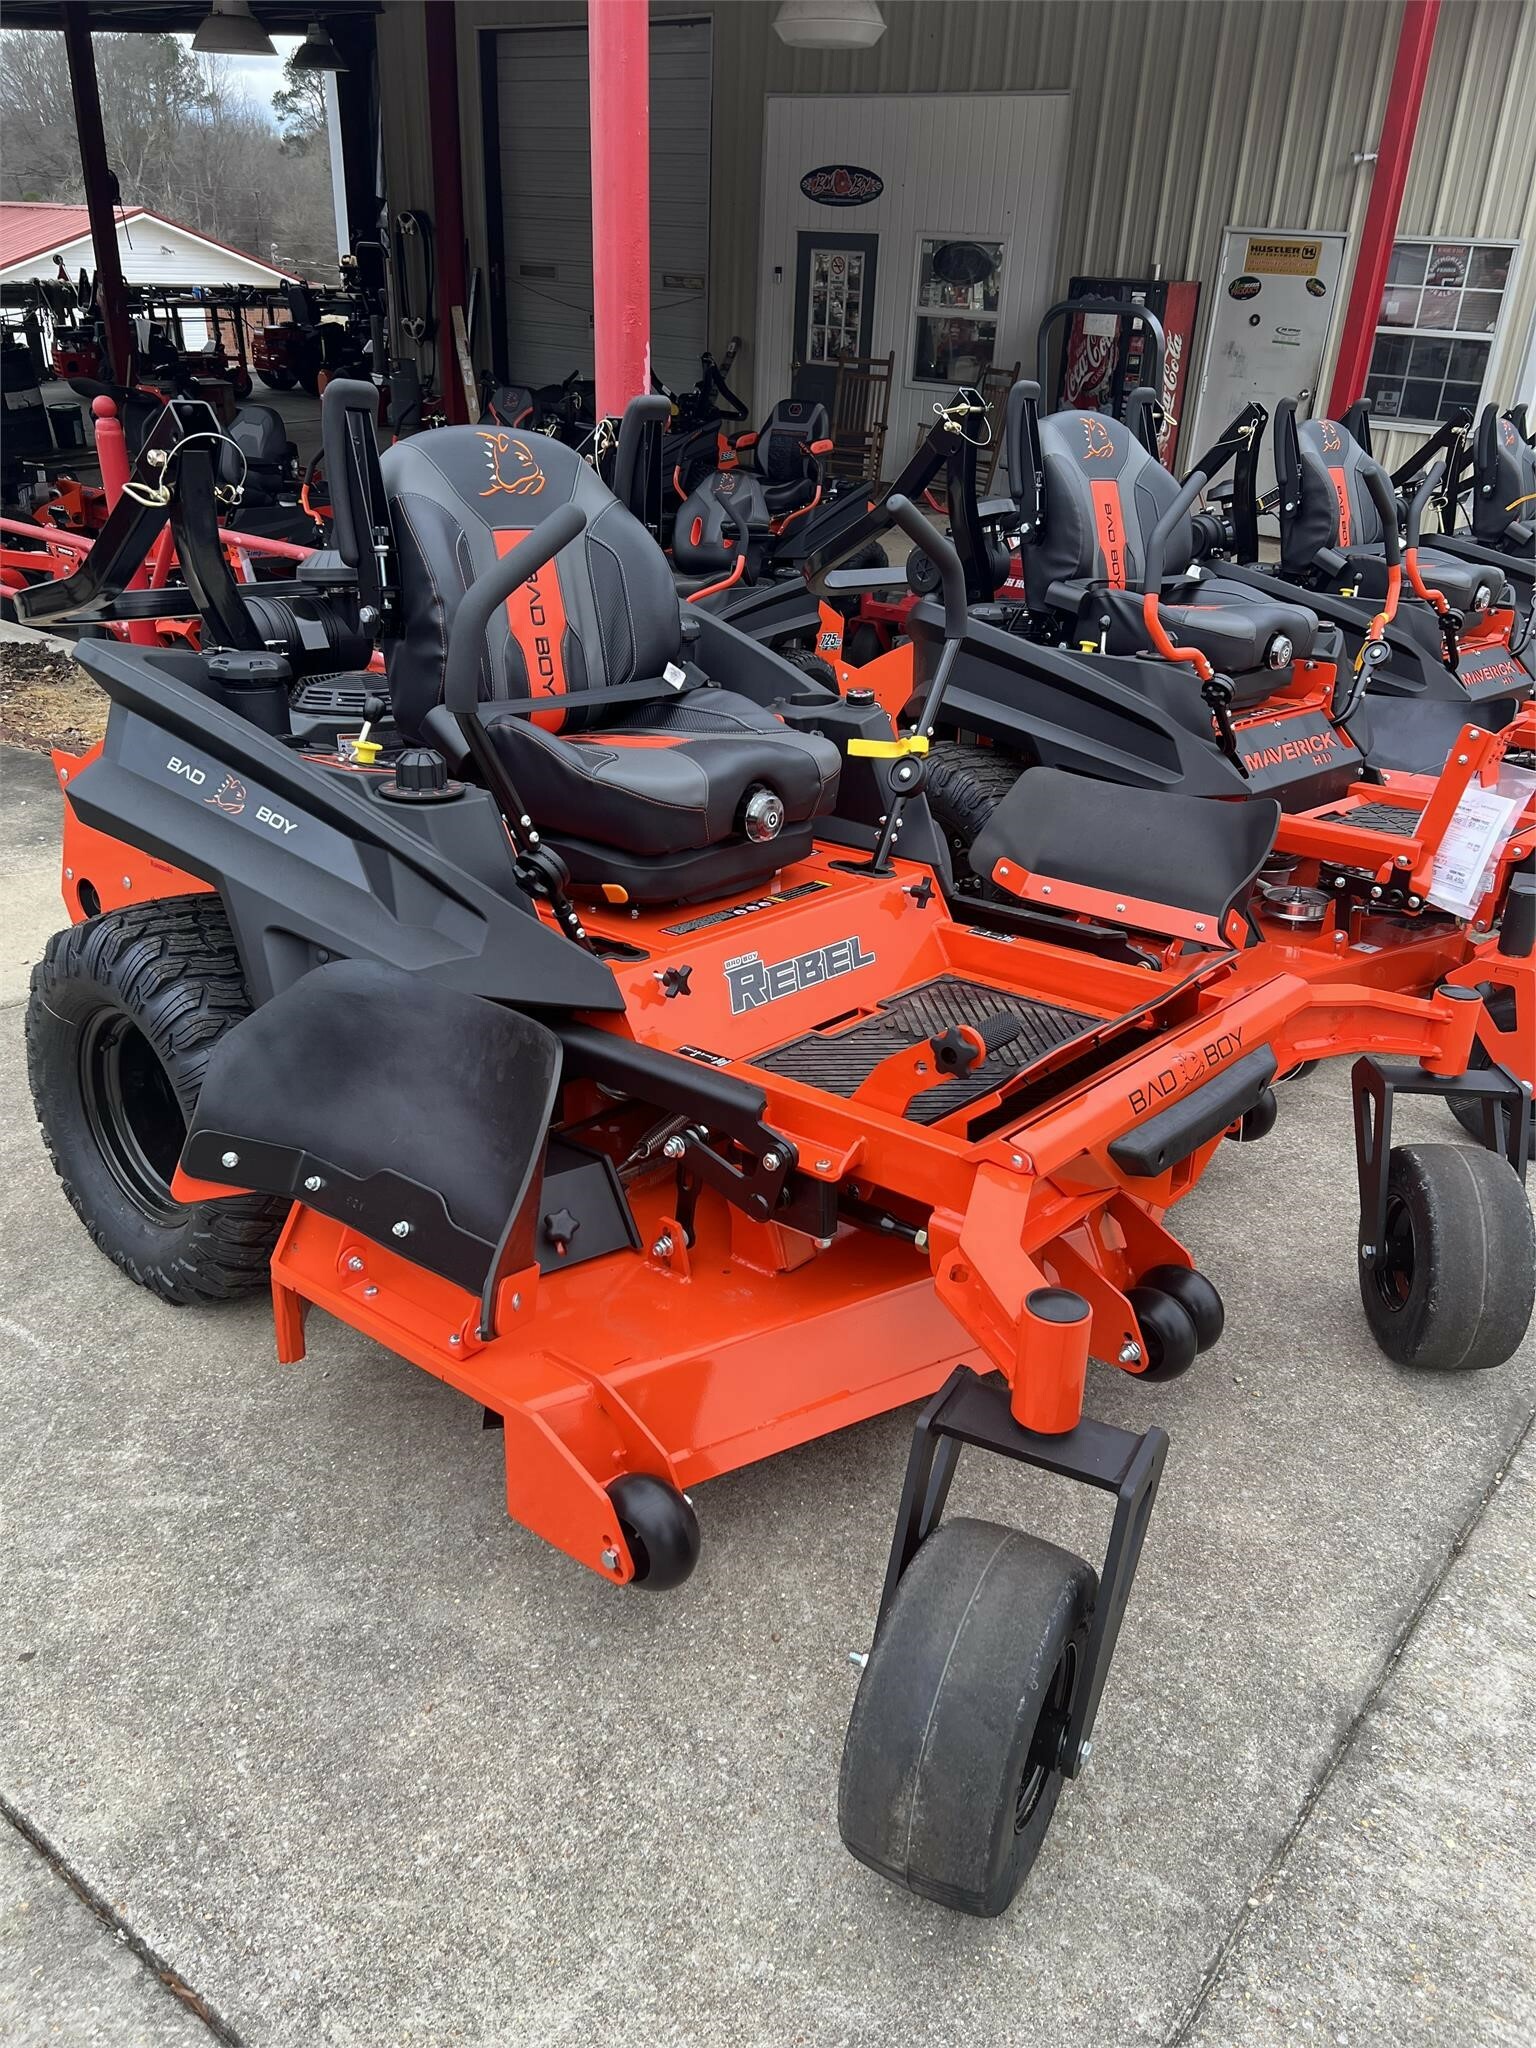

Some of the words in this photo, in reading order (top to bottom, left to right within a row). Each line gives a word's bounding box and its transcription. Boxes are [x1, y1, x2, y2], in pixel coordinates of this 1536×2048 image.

[1250, 245, 1300, 254] HUSTLER
[1337, 485, 1346, 515] BAD
[1104, 503, 1116, 542] BAD
[1111, 550, 1121, 589] BOY
[535, 637, 556, 696] BOY
[1461, 661, 1516, 687] MAVERICK
[1244, 731, 1338, 772] MAVERICK
[1312, 752, 1332, 766] HD
[166, 756, 206, 785] BAD
[255, 805, 298, 834] BOY
[723, 935, 876, 1015] REBEL
[725, 957, 741, 969] BAD
[741, 951, 759, 964] BOY
[1128, 1069, 1178, 1115] BAD
[1203, 1026, 1242, 1067] BOY
